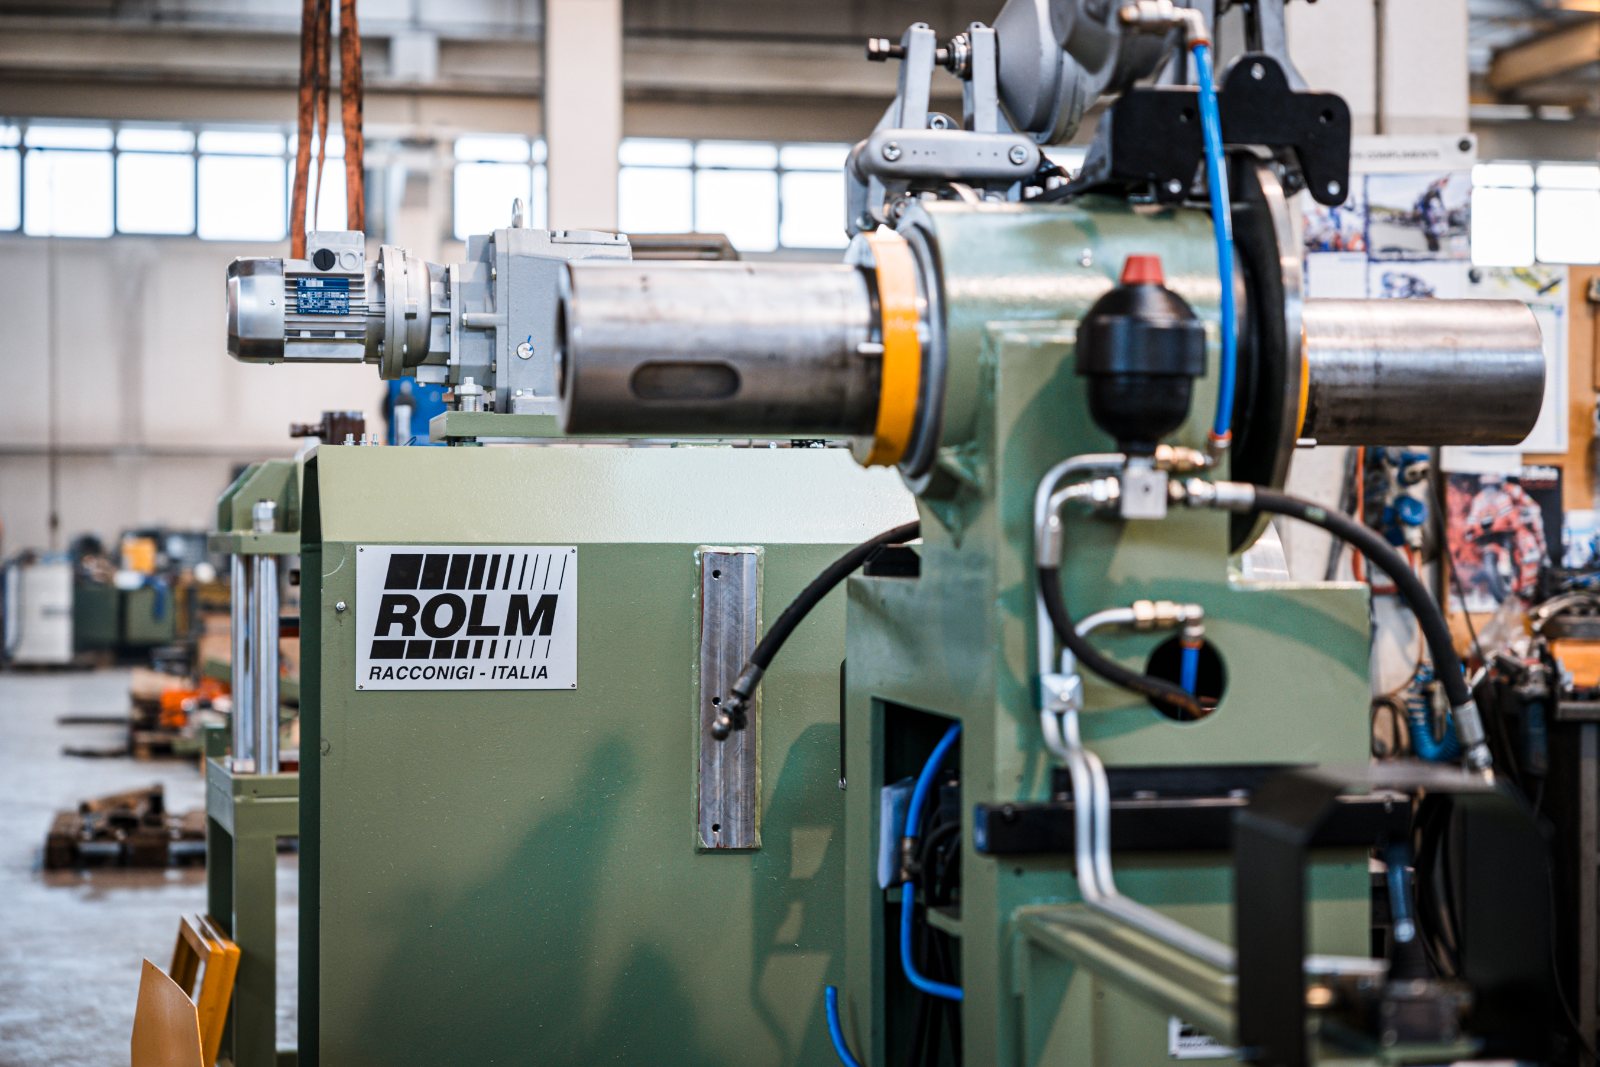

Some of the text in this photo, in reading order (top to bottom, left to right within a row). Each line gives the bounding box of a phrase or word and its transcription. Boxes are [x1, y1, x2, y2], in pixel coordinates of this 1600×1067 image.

[373, 592, 559, 639] ROLM
[369, 665, 475, 681] RACCONIGI
[491, 665, 548, 680] ITALIA
